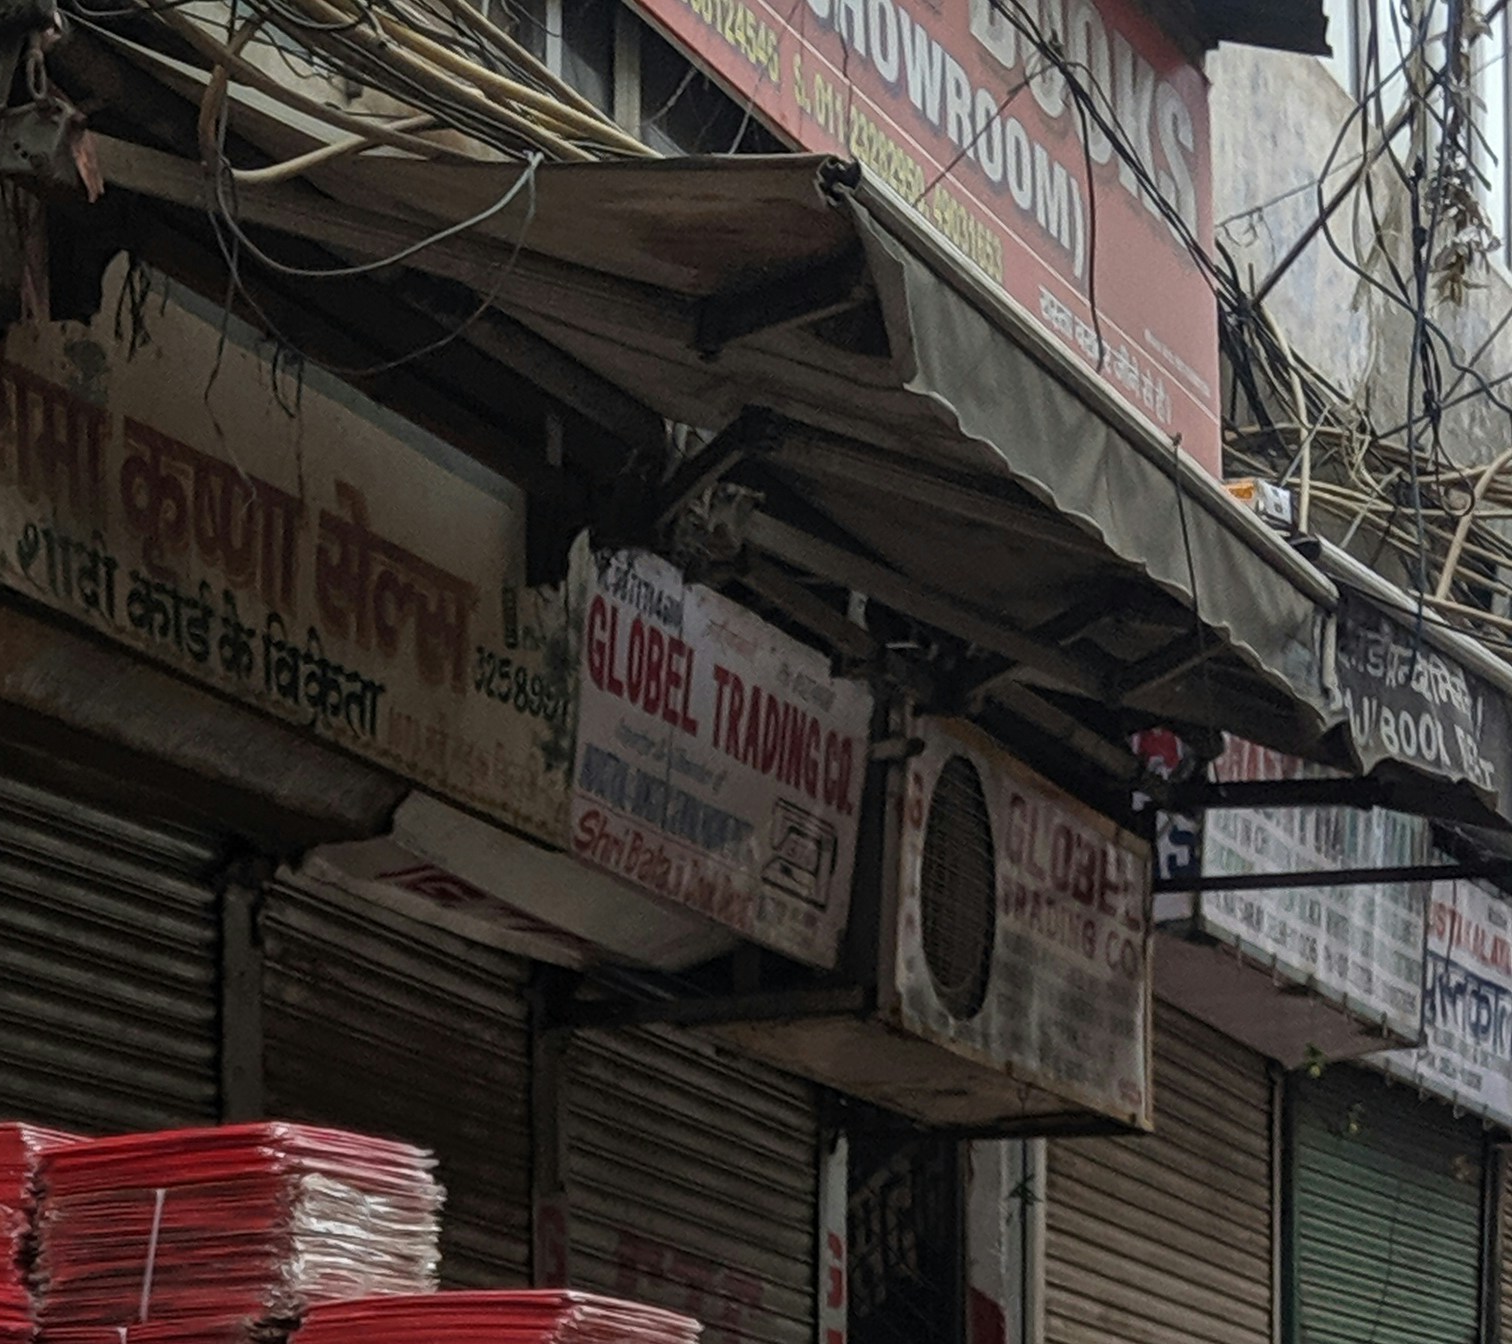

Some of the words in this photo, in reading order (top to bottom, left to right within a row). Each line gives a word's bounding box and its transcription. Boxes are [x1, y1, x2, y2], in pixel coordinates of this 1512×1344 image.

[126, 580, 213, 663] कार्ड
[219, 588, 255, 681] के
[587, 594, 698, 738] GLOBEL
[712, 663, 822, 801] TRADING
